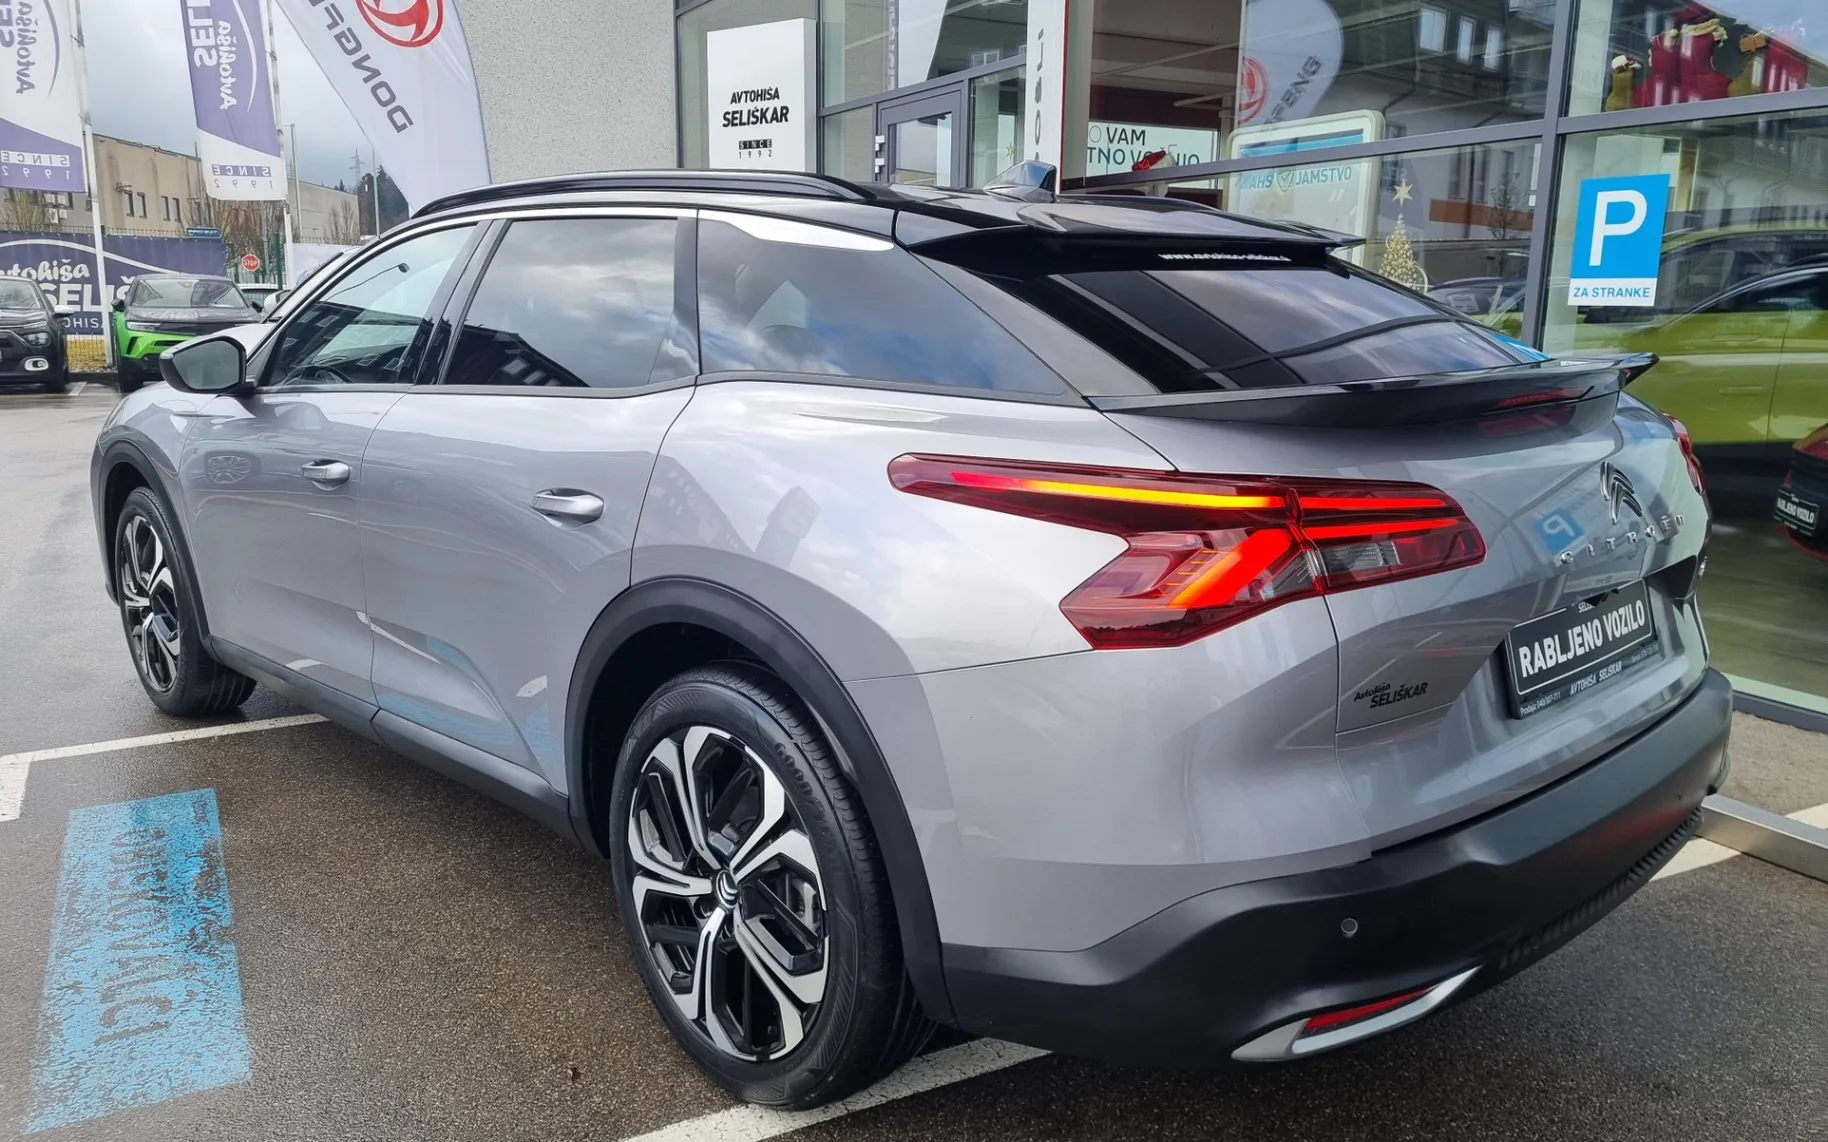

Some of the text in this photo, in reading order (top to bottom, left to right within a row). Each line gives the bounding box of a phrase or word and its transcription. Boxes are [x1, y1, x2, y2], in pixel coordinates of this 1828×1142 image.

[730, 86, 780, 105] AVTOHIŠA
[722, 105, 790, 128] SELIŠKAR
[739, 139, 772, 149] SINCE
[1106, 127, 1146, 146] VAM
[739, 149, 772, 159] 1992
[1296, 166, 1352, 186] JAMSTVO
[1589, 189, 1647, 266] P
[1573, 287, 1650, 297] ZA STRANKE
[1518, 599, 1646, 679] RABLJENO VOZILO
[1370, 682, 1428, 708] SELIŠKAR
